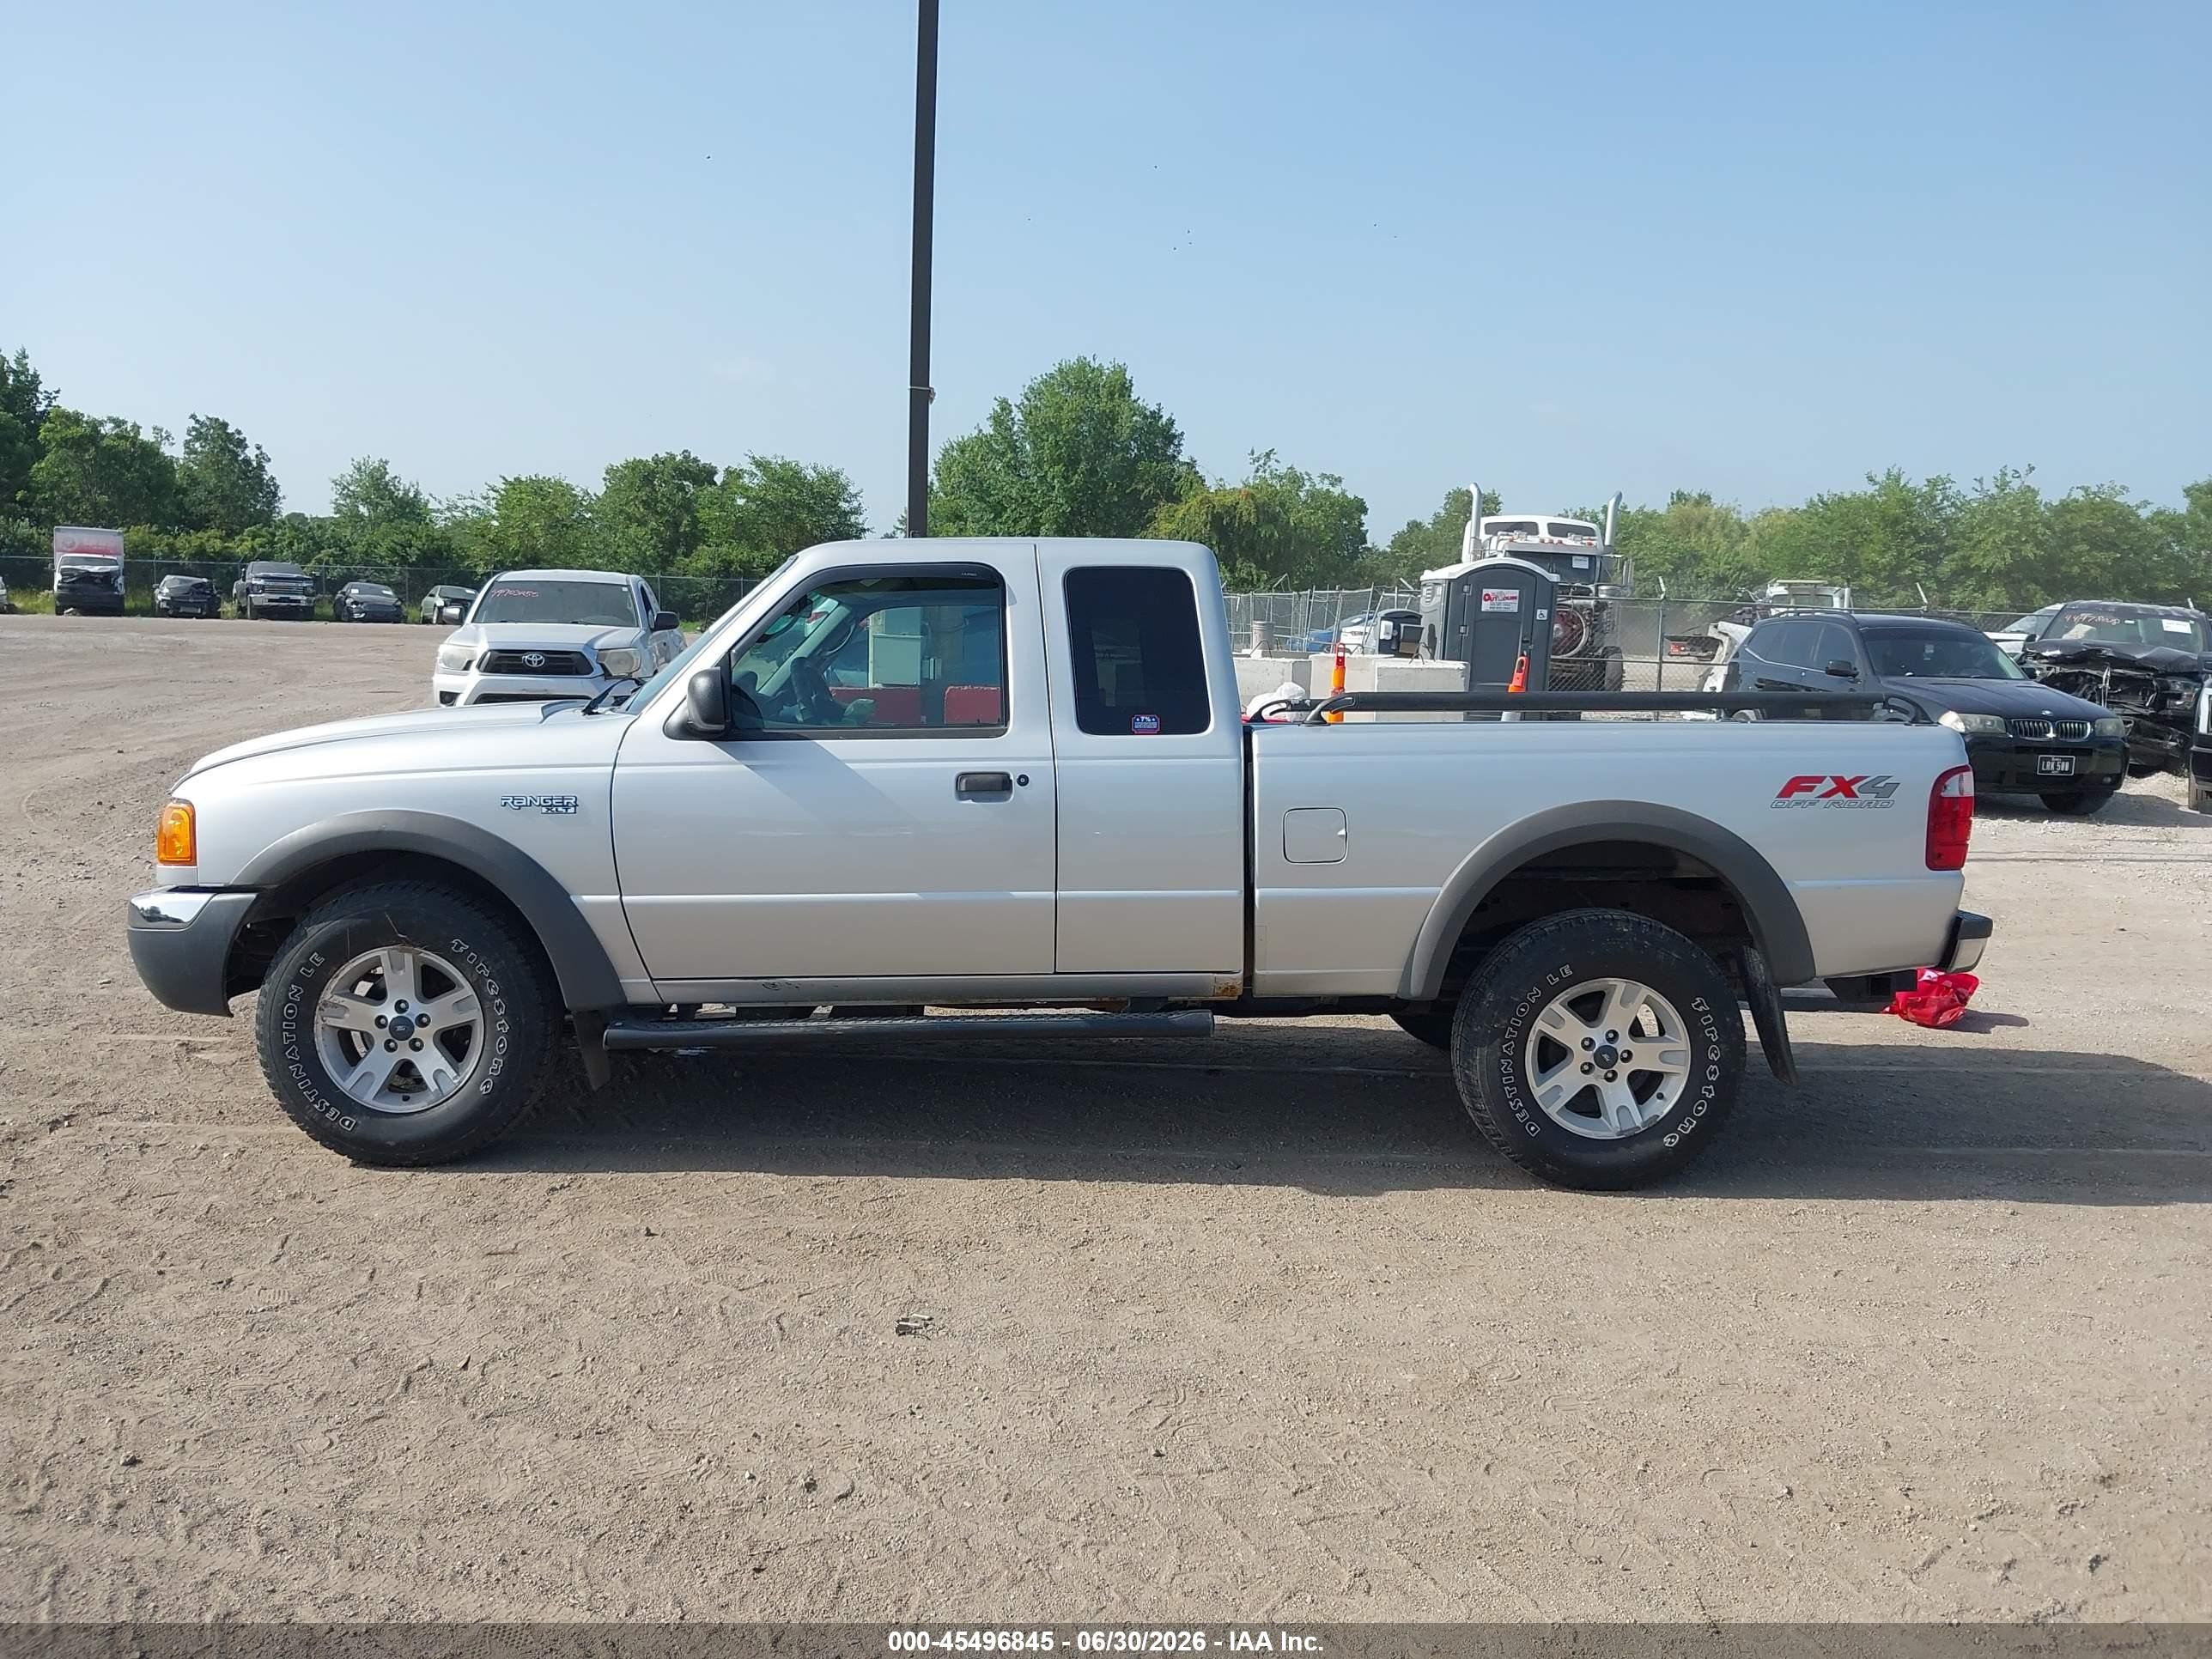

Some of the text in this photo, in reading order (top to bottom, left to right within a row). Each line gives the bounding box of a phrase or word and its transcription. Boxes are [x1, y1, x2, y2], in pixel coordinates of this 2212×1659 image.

[1770, 799, 1897, 809] OFF ROAD
[1776, 775, 1901, 798] FX4
[283, 951, 357, 1132] DESTINATION LE
[1499, 963, 1574, 1138] DESTINATION LE
